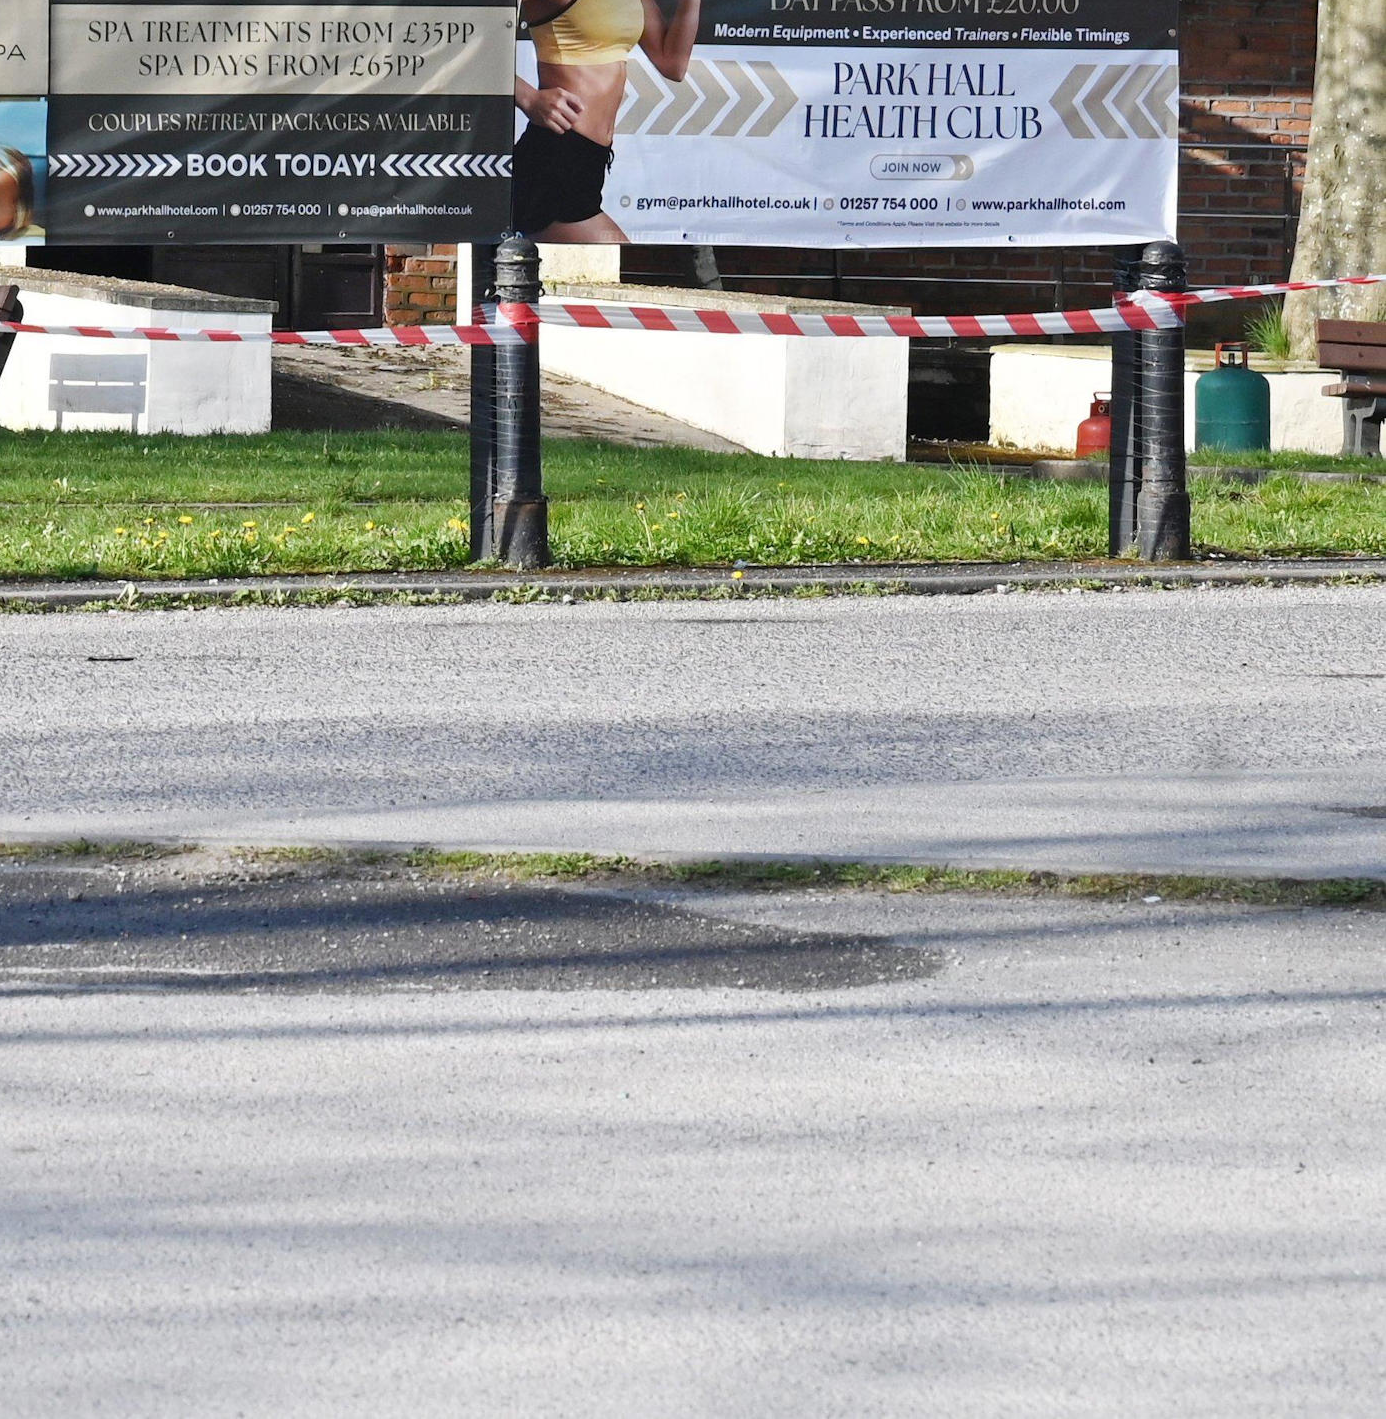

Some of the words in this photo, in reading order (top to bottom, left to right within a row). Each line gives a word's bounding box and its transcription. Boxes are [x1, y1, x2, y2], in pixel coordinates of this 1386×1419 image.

[88, 20, 133, 43] SPA
[142, 20, 311, 43] TREATMENTS
[321, 21, 393, 43] FROM
[402, 21, 475, 44] £35PP
[714, 23, 769, 38] Modern
[773, 25, 849, 41] Equipment
[862, 26, 951, 42] Experienced
[955, 27, 1009, 41] Trainers
[1020, 27, 1073, 42] Flexible
[1075, 28, 1130, 44] Timings
[138, 54, 183, 76] SPA
[193, 54, 257, 76] DAYS
[267, 55, 339, 76] FROM
[349, 55, 425, 78] £65PP
[833, 62, 920, 95] PARK
[928, 63, 1016, 96] HALL
[88, 113, 181, 132] COUPLES
[185, 113, 267, 132] RETREAT
[271, 113, 370, 132] PACKAGES
[373, 113, 471, 132] AVAILABLE
[804, 104, 937, 139] HEALTH
[947, 106, 1042, 140] CLUB
[186, 154, 267, 177] BOOK
[274, 154, 376, 177] TODAY!
[881, 162, 910, 173] JOIN
[912, 162, 942, 173] NOW
[97, 204, 218, 217] www.parkhallhotel.com
[242, 204, 273, 216] 01257
[276, 204, 296, 216] 754
[298, 204, 321, 216] 000
[350, 203, 473, 217] spa@parkhallhotel.co.uk
[637, 196, 810, 211] gym@parkhallhotel.co.uk
[840, 197, 878, 210] 01257
[882, 198, 906, 210] 754
[909, 198, 938, 210] 000
[971, 198, 1126, 213] www.parkhallhotel.com
